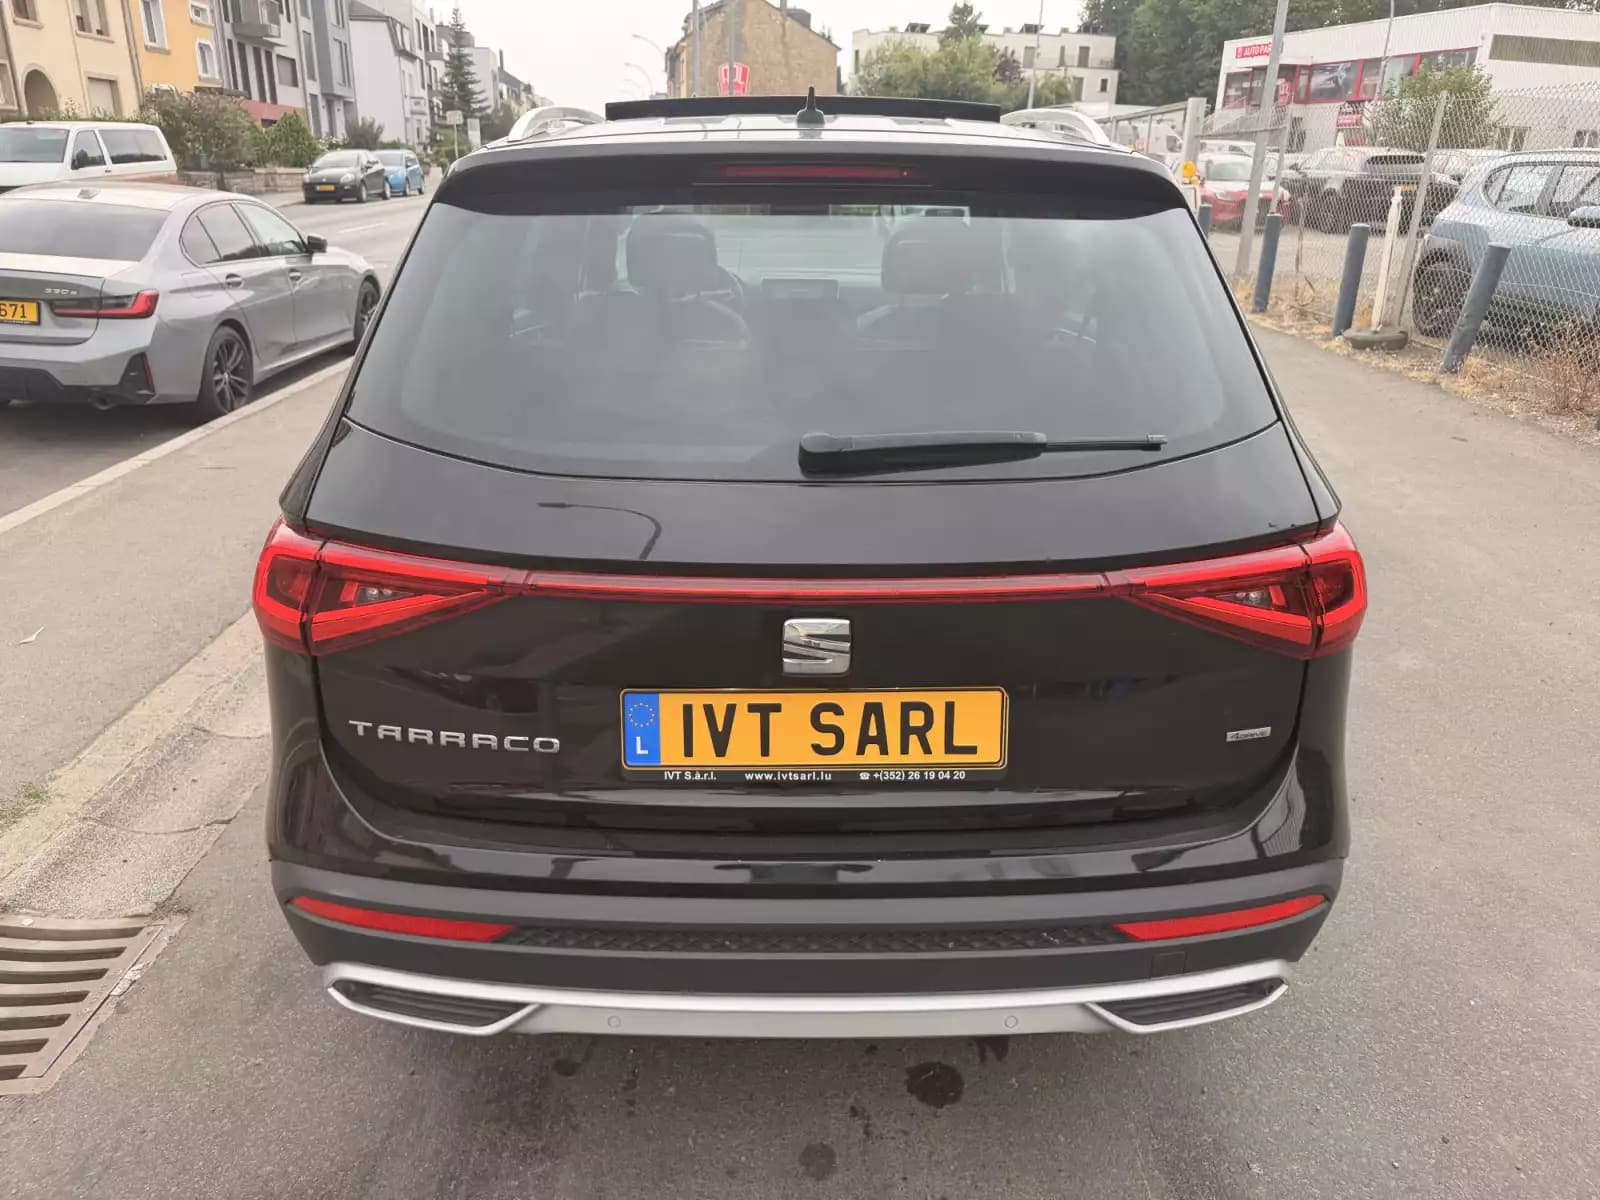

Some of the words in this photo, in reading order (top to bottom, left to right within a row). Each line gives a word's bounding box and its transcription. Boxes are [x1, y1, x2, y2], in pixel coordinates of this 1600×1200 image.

[348, 719, 560, 753] TARRACO
[682, 702, 782, 757] IVT
[810, 700, 978, 756] SARL
[636, 736, 649, 755] L
[664, 771, 681, 780] IVT
[744, 771, 832, 781] www.ivtsarl.lu
[873, 770, 905, 781] +(352)
[907, 770, 921, 780] 26
[924, 770, 935, 780] 19
[938, 770, 950, 780] 04
[952, 770, 966, 780] 20
